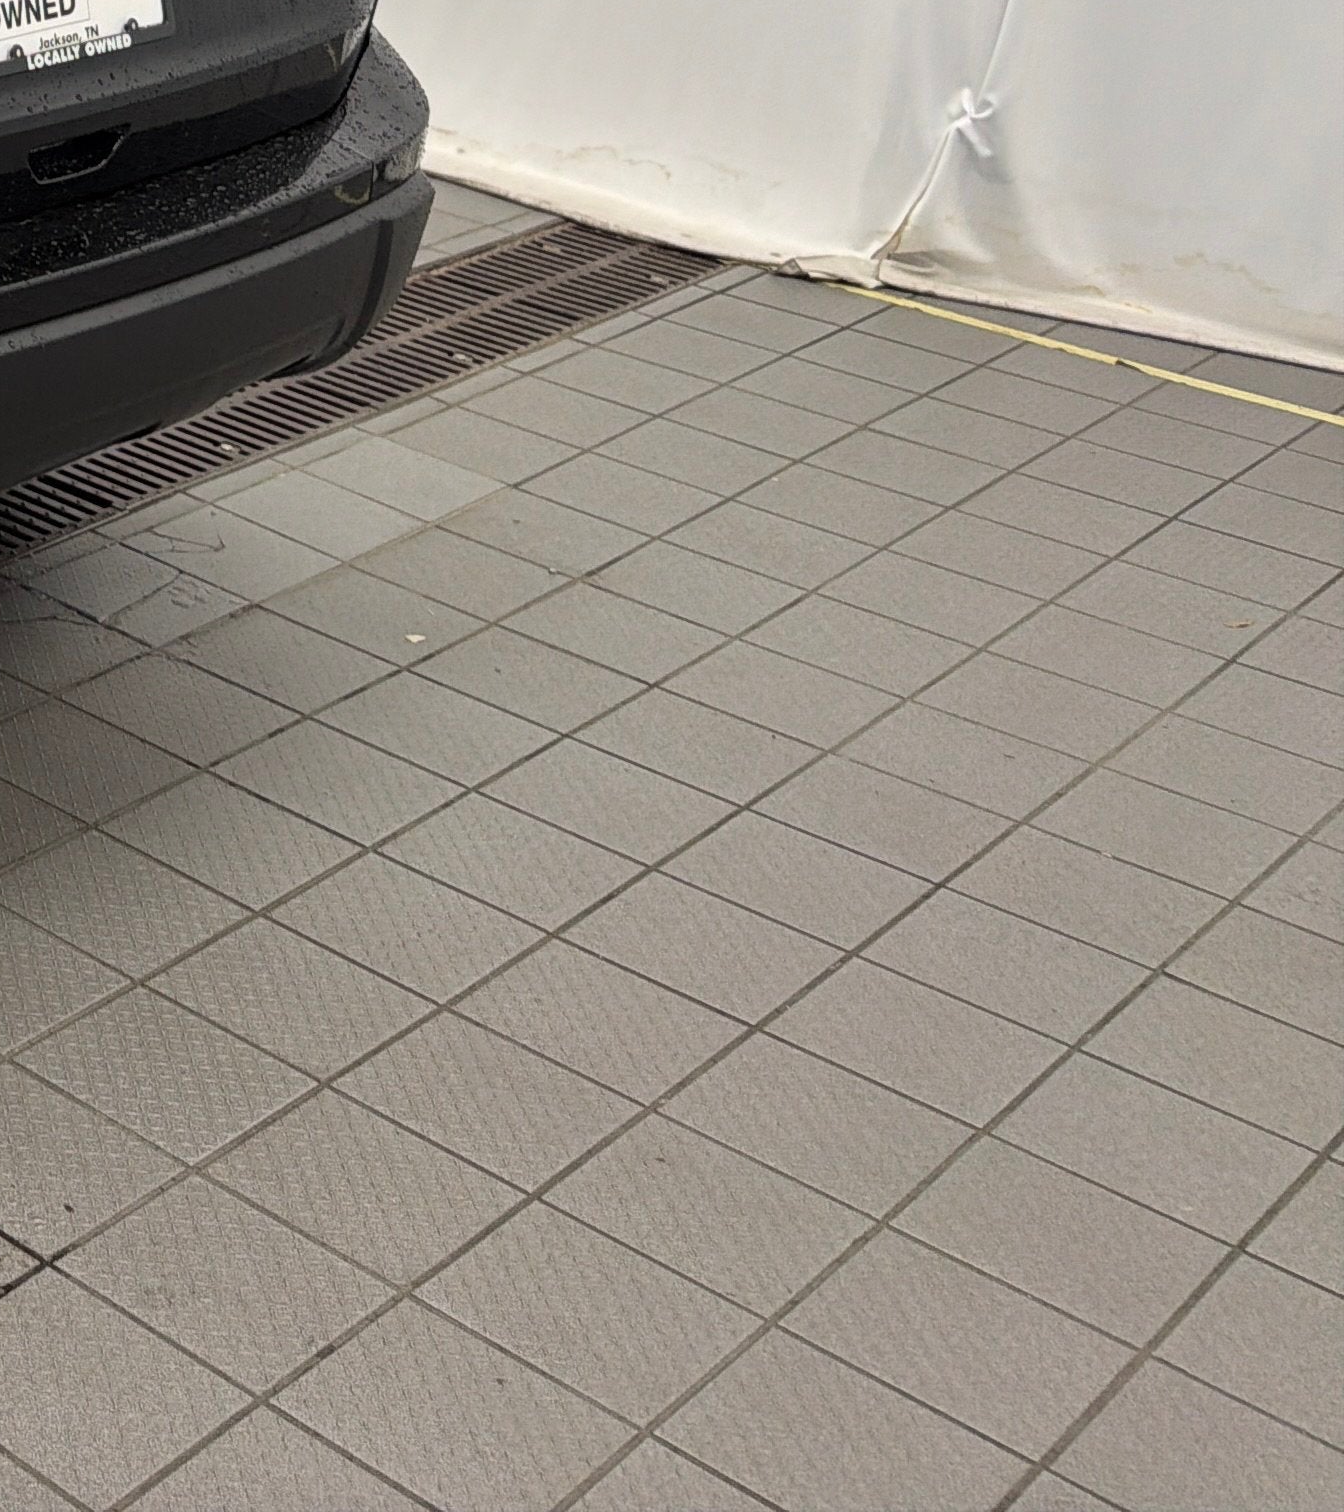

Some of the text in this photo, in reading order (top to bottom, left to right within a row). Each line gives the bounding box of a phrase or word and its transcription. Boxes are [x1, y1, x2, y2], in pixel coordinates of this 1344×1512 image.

[26, 33, 132, 71] LOCALLY OWNED
[39, 24, 99, 51] Jackson, TN
